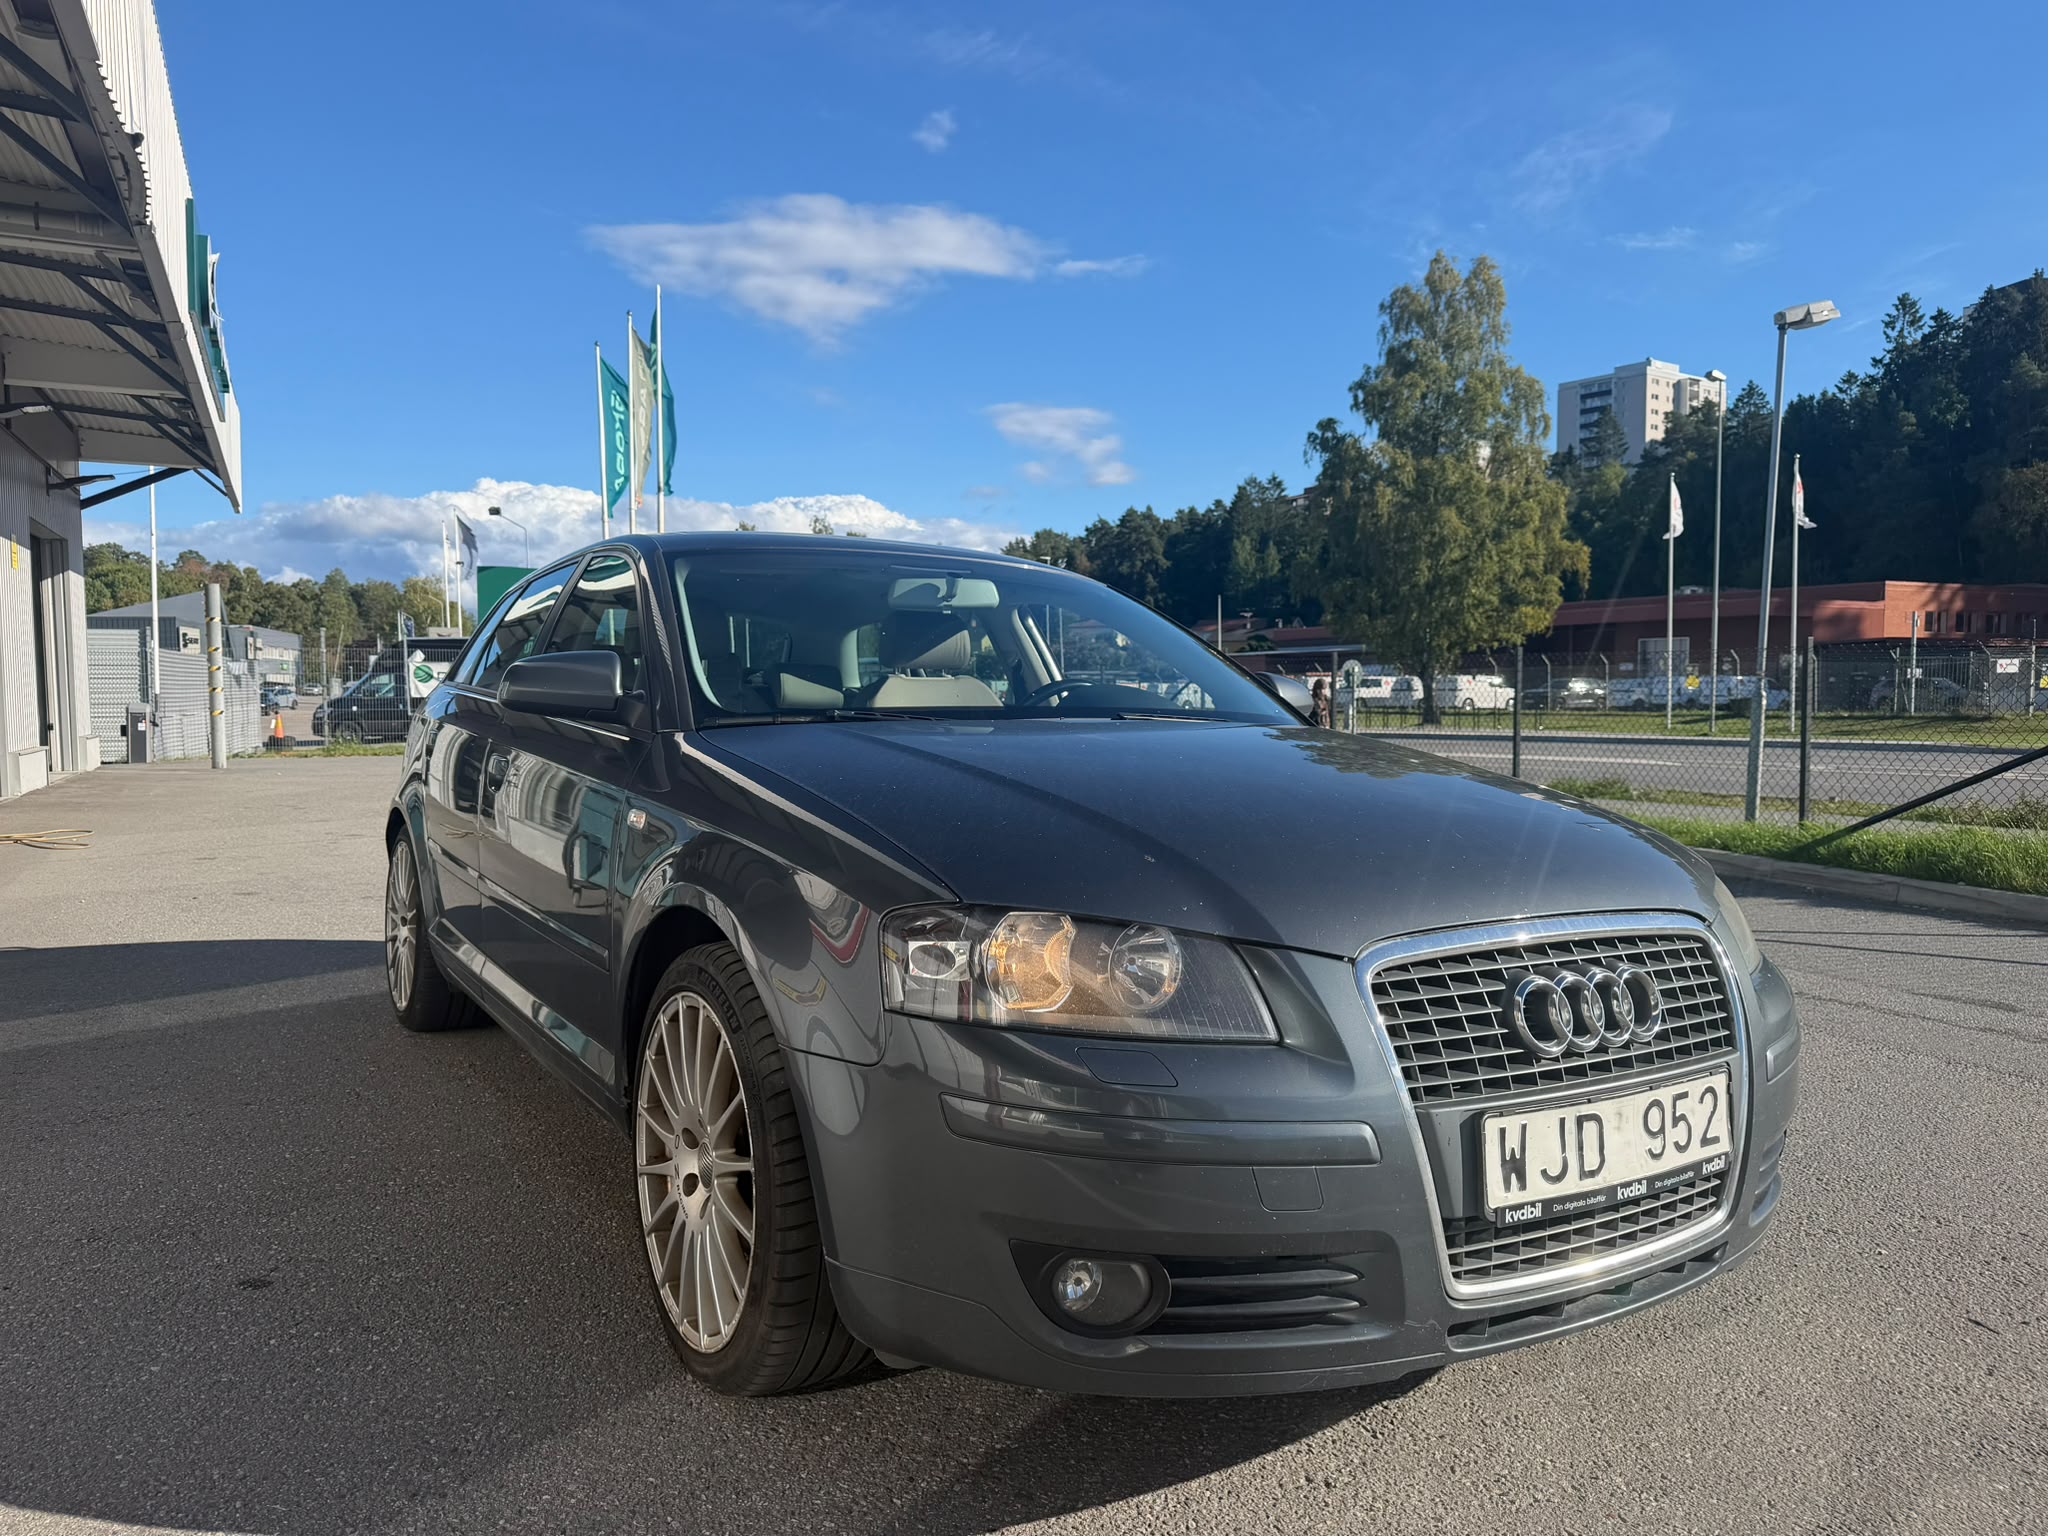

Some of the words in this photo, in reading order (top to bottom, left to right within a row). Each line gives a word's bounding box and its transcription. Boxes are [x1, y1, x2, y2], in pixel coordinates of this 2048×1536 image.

[699, 970, 739, 1030] MICHELIN
[1499, 1112, 1606, 1194] WJD
[1642, 1085, 1721, 1161] 952
[1505, 1202, 1542, 1224] kvdbil
[1553, 1204, 1564, 1212] Din
[1564, 1200, 1586, 1211] digitala
[1617, 1180, 1647, 1201] kvdbil
[1701, 1155, 1726, 1175] kvdbil
